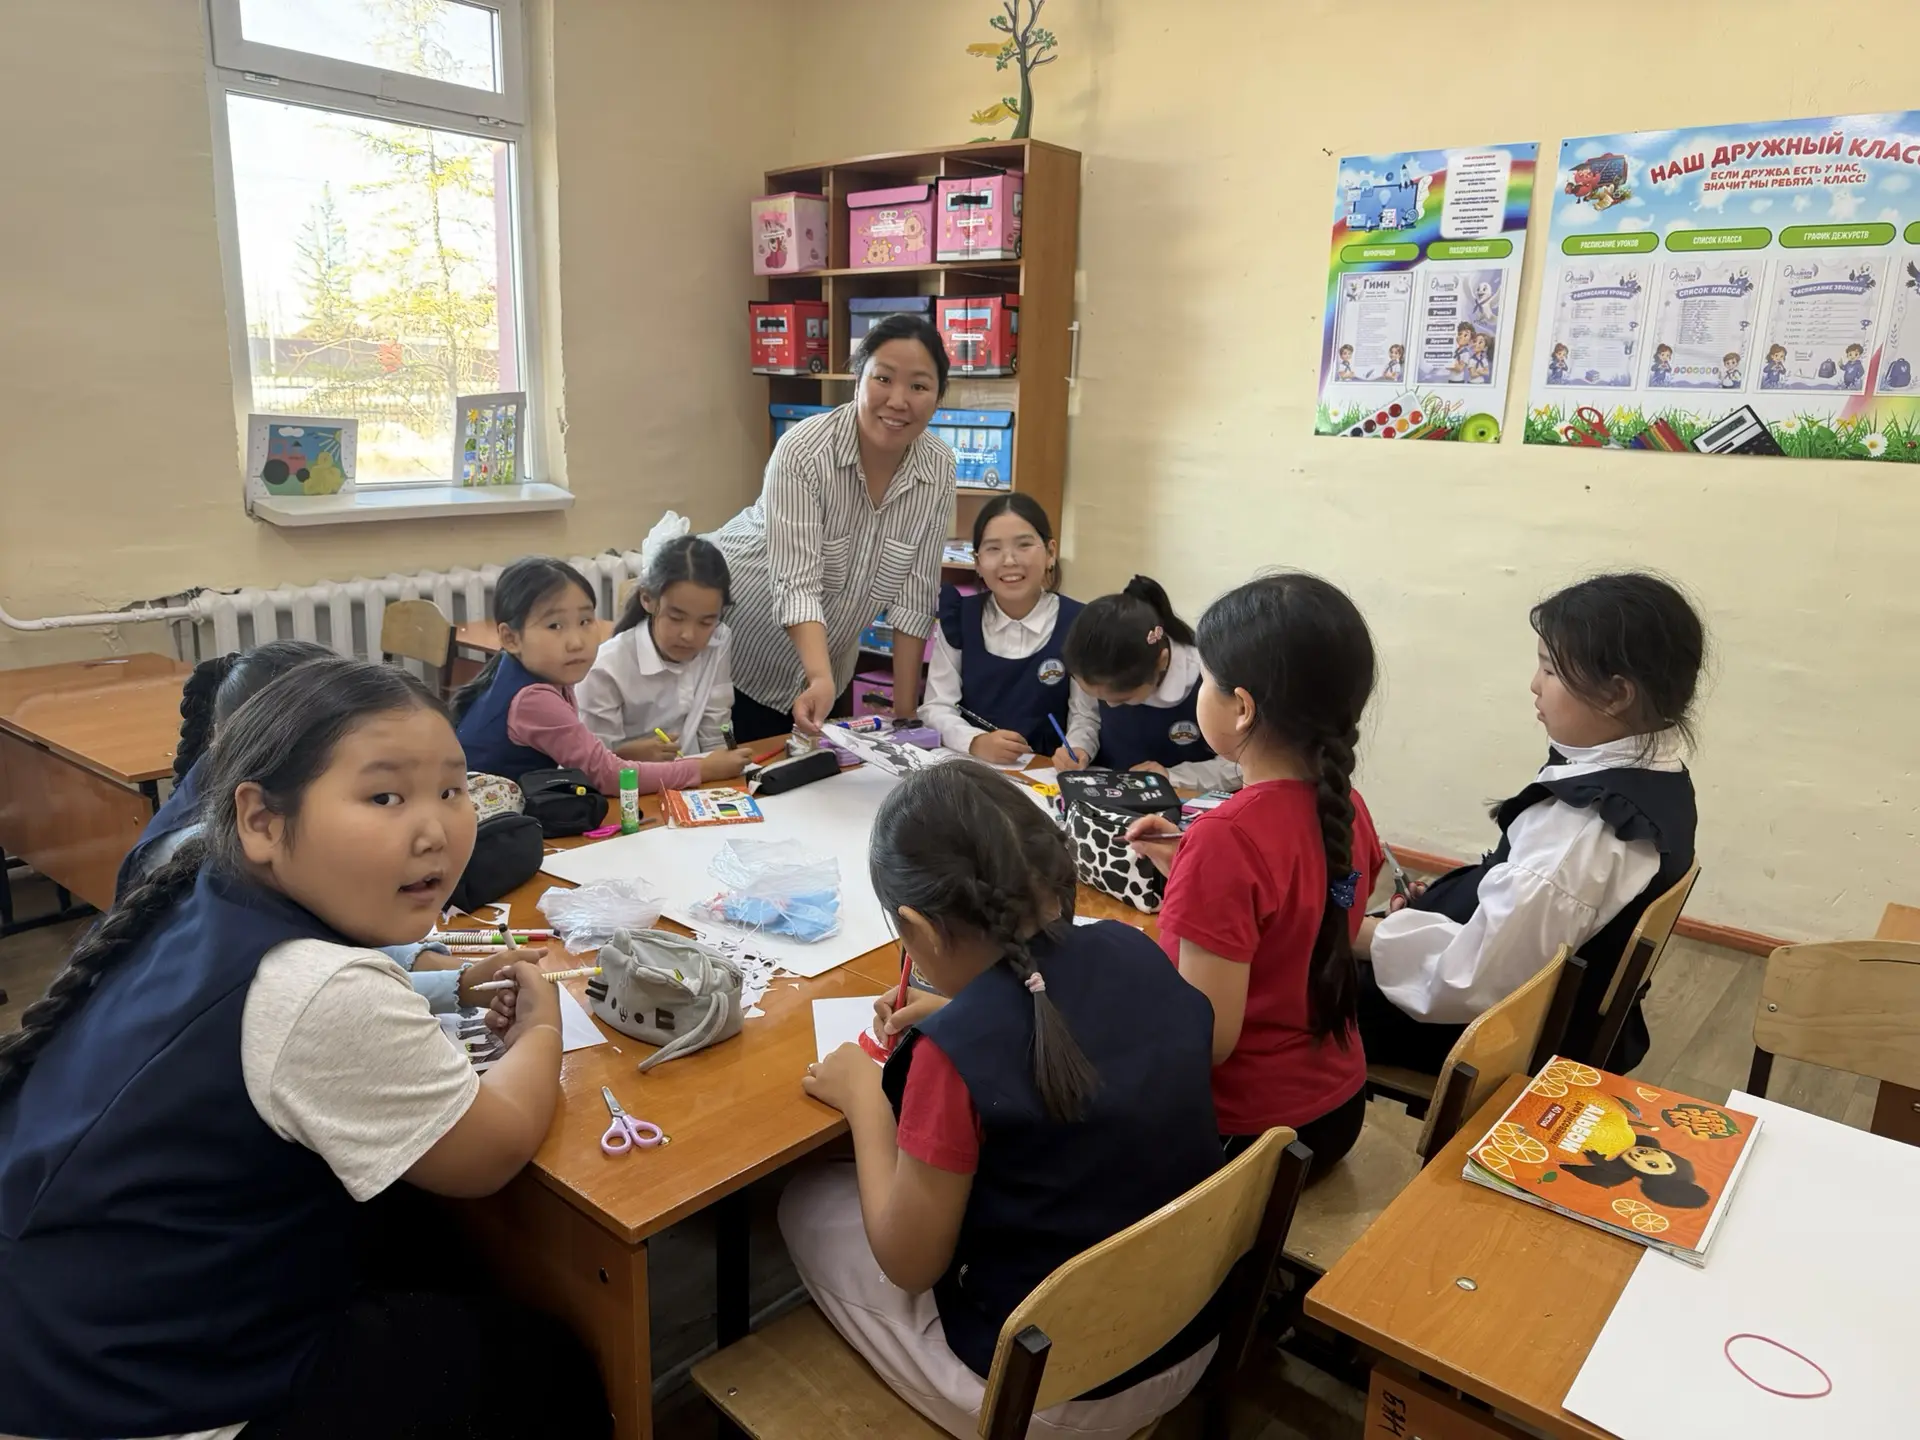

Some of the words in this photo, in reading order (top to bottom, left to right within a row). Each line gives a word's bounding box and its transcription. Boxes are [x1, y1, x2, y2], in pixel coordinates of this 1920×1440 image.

[1650, 152, 1704, 184] НАШ
[1711, 131, 1844, 168] ДРУЖНЫЙ
[1848, 138, 1920, 166] КЛАС
[1710, 166, 1740, 181] ЕСЛИ
[1741, 165, 1790, 180] ДРУЖБА
[1792, 164, 1823, 176] ЕСТЬ
[1824, 164, 1833, 174] У
[1834, 163, 1861, 174] НАС,
[1703, 179, 1748, 192] ЗНАЧИТ
[1749, 179, 1769, 190] МЫ
[1770, 176, 1814, 188] РЕБЯТА
[1823, 173, 1867, 185] КЛАСС!
[1692, 235, 1717, 245] СПИСОК
[1717, 235, 1743, 244] КЛАССА
[1803, 231, 1832, 241] ГРАФИК
[1831, 230, 1870, 241] ДЕЖУРСТВ
[1580, 240, 1616, 249] РАСПИСАНИЕ
[1616, 239, 1639, 248] УРОКОВ
[1363, 279, 1390, 290] Гимн
[1679, 287, 1709, 298] СПИСОК
[1710, 286, 1742, 295] КЛАССА
[1557, 1103, 1606, 1154] АЛЬБОМ
